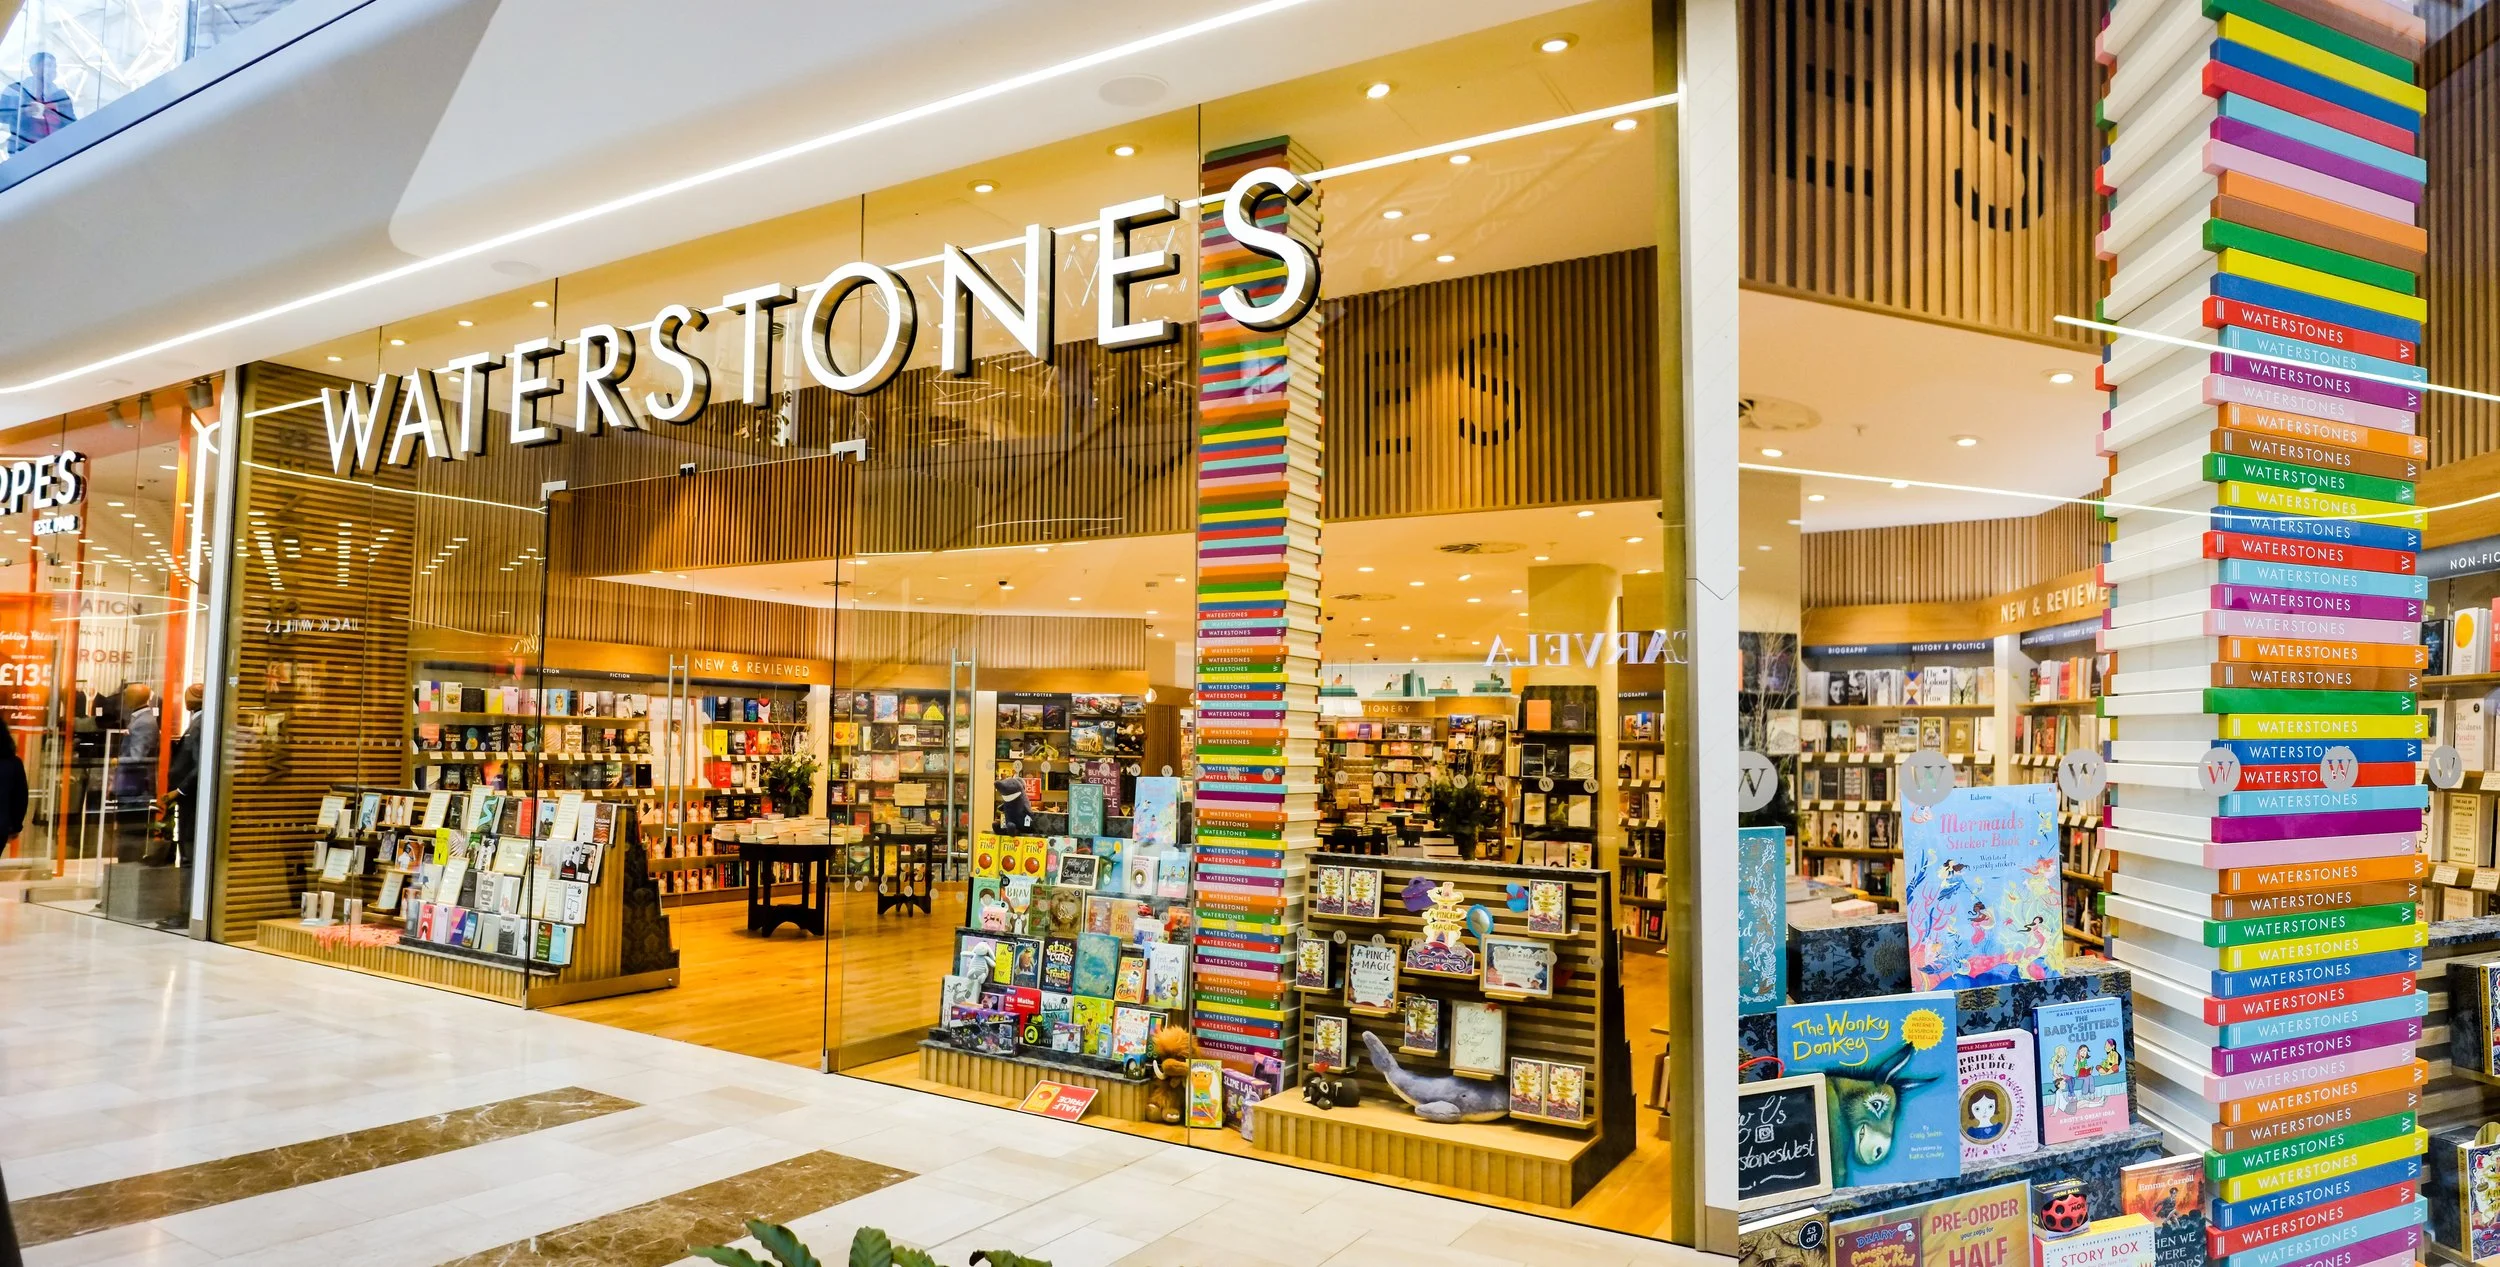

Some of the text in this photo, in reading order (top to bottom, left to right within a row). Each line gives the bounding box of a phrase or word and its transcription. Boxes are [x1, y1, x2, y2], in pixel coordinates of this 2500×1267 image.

[321, 167, 1318, 474] WATERSTONES
[2242, 308, 2409, 358] WATERSTONES W
[2257, 338, 2356, 370] WATERSTONES
[2250, 361, 2350, 393] WATERSTONES
[2243, 385, 2344, 416] WATERSTONES
[2257, 414, 2357, 443] WATERSTONES
[2250, 439, 2350, 466] WATERSTONES
[2244, 464, 2410, 500] WATERSTONES W
[2257, 490, 2356, 514] WATERSTONES
[2250, 518, 2350, 538] WATERSTONES
[2242, 540, 2410, 570] WATERSTONES W
[2257, 566, 2357, 587] WATERSTONES
[2001, 581, 2109, 624] NEW & REVIEWE
[2250, 592, 2350, 610] WATERSTONES
[2244, 617, 2345, 634] WATERSTONES
[1912, 644, 1941, 652] HISTORY
[1952, 642, 1986, 650] POLITICS
[2258, 644, 2358, 660] WATERSTONES
[695, 658, 811, 678] NEW & REVIEWED
[2251, 670, 2352, 684] WATERSTONES
[2402, 696, 2410, 710] W
[2258, 721, 2358, 733] WATERSTONES
[2064, 763, 2098, 791] W
[2207, 758, 2234, 785] W
[2327, 758, 2352, 780] W
[1102, 778, 1117, 786] ONE
[2258, 794, 2358, 808] WATERSTONES
[1940, 810, 2025, 834] Mermaids
[1946, 833, 2019, 850] Sticker Book
[1206, 848, 1248, 856] WATERSTONES
[1206, 875, 1248, 884] WATERSTONES
[2258, 866, 2358, 884] WATERSTONES
[2251, 892, 2352, 911] WATERSTONES
[2244, 908, 2410, 937] WATERSTONES W
[1201, 938, 1244, 949] WATERSTONES
[1204, 930, 1248, 940] WATERSTONES
[1357, 949, 1391, 961] A PINCH
[2259, 939, 2358, 961] WATERSTONES
[1204, 958, 1248, 968] WATERSTONES
[1362, 960, 1391, 972] MAGIC
[2250, 964, 2350, 988] WATERSTONES
[1017, 997, 1035, 1005] Maths
[1201, 994, 1244, 1004] WATERSTONES
[2243, 988, 2344, 1015] WATERSTONES
[1201, 1022, 1244, 1033] WATERSTONES
[1204, 1012, 1247, 1024] WATERSTONES
[1792, 1010, 1890, 1040] The Wonky
[2044, 1017, 2120, 1037] BABY-SITTERS
[2258, 1010, 2358, 1038] WATERSTONES
[1204, 1040, 1246, 1052] WATERSTONES
[2068, 1030, 2098, 1043] CLUB
[1793, 1036, 1869, 1067] Donkey
[1960, 1053, 2005, 1066] PRIDE &
[2251, 1036, 2352, 1064] WATERSTONES
[1960, 1062, 2016, 1075] REJUDICE
[2244, 1062, 2346, 1092] WATERSTONES
[1224, 1076, 1240, 1090] SLIME
[2258, 1082, 2358, 1113] WATERSTONES
[1052, 1104, 1082, 1114] HALF
[2251, 1108, 2352, 1140] WATERSTONES
[2243, 1118, 2411, 1168] WATERSTONES W
[2258, 1154, 2358, 1190] WATERSTONES
[2139, 1174, 2194, 1191] Emma Carroll
[2250, 1180, 2350, 1216] WATERSTONES
[1932, 1198, 2019, 1235] PRE-ORDER
[2242, 1206, 2344, 1244] WATERSTONES
[1806, 1233, 1818, 1244] off
[1807, 1225, 1817, 1235] £3
[1856, 1228, 1897, 1248] DIARY
[1960, 1232, 1972, 1240] your
[1973, 1229, 1986, 1237] copy
[2154, 1231, 2197, 1249] HEN WE
[1851, 1244, 1905, 1263] Awesome
[1949, 1236, 2008, 1267] HALF
[2061, 1247, 2105, 1267] STORY
[2111, 1241, 2139, 1256] BOX
[2156, 1246, 2187, 1262] WERE
[2258, 1226, 2358, 1265] WATERSTONES
[1892, 1252, 1916, 1267] Kid
